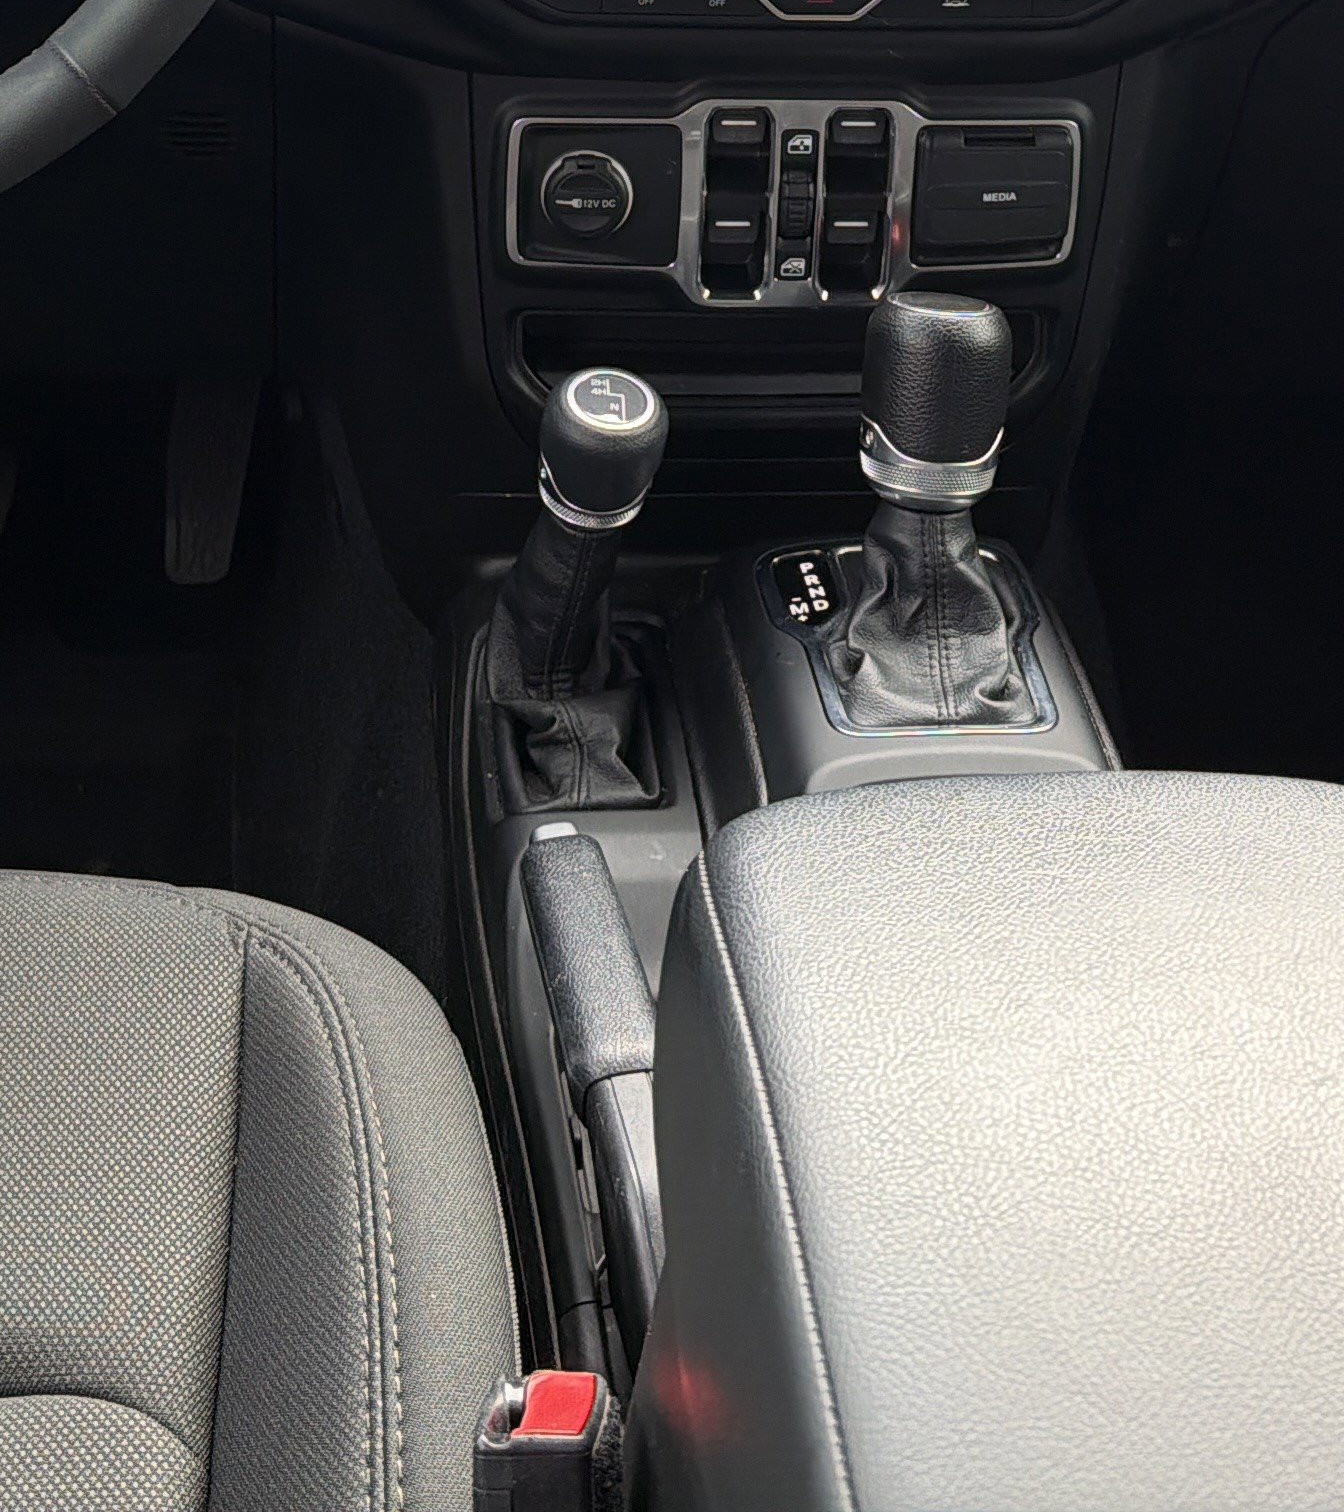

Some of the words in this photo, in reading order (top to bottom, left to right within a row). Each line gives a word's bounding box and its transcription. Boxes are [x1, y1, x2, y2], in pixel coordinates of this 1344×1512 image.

[982, 192, 1017, 202] MEDIA
[583, 199, 601, 208] 12V
[601, 199, 617, 208] DC
